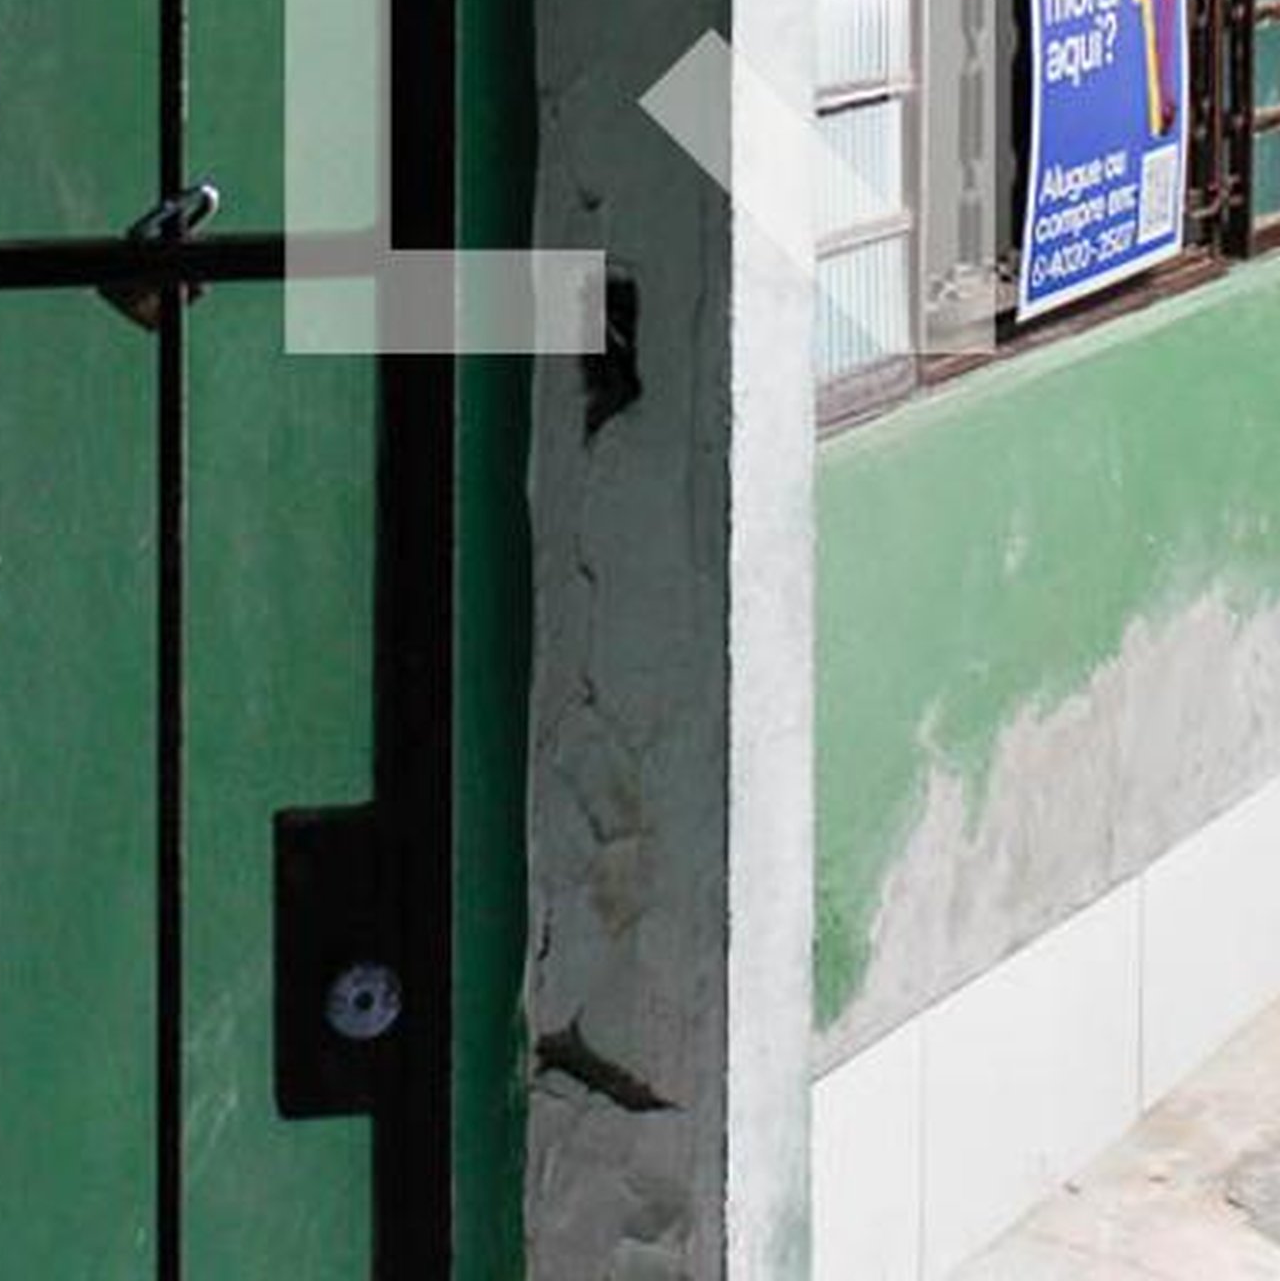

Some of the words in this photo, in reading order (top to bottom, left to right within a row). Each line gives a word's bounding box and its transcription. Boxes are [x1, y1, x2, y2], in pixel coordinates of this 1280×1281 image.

[1046, 11, 1117, 88] aqui?
[1039, 159, 1102, 207] Alugue
[1035, 197, 1105, 244] compre
